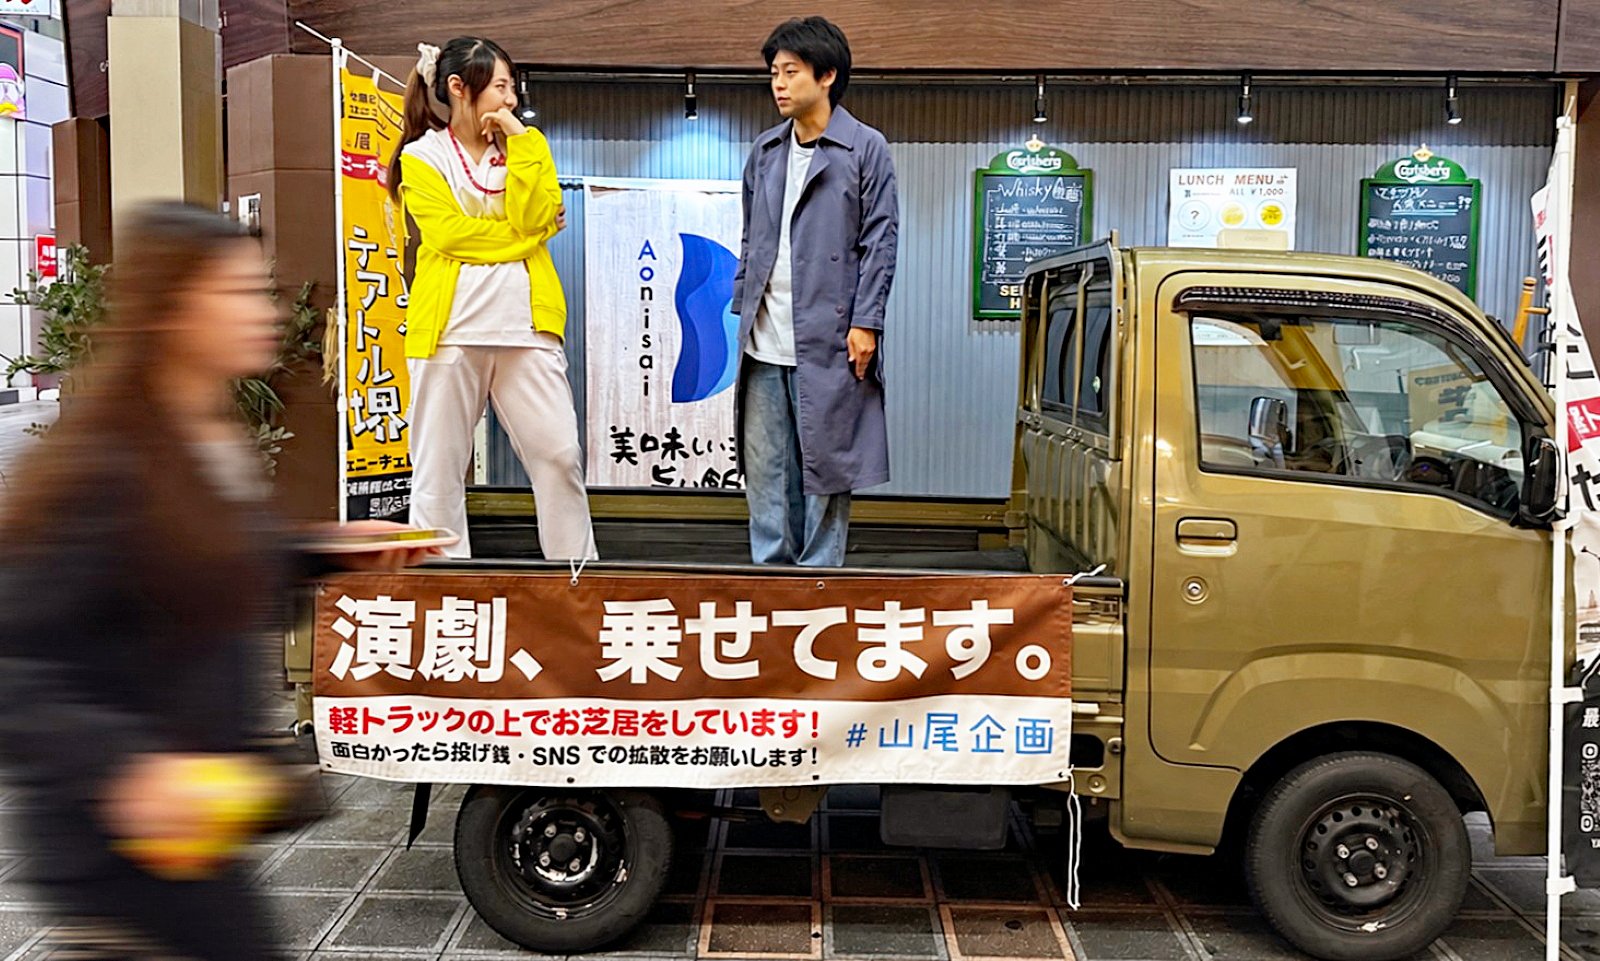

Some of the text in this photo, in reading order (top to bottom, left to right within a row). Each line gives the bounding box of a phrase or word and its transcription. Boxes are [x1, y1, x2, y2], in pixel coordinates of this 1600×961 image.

[1006, 151, 1062, 172] Carlsberg
[1394, 160, 1451, 182] Carlsberg
[1178, 174, 1274, 186] LUNCH MENU
[1000, 285, 1024, 297] SE
[638, 240, 657, 396] Aonisai
[348, 225, 408, 443] テアトル堺
[329, 595, 1051, 684] 演劇、 乗せてます。
[329, 706, 819, 738] 軽トラックの上でお芝居をしています！
